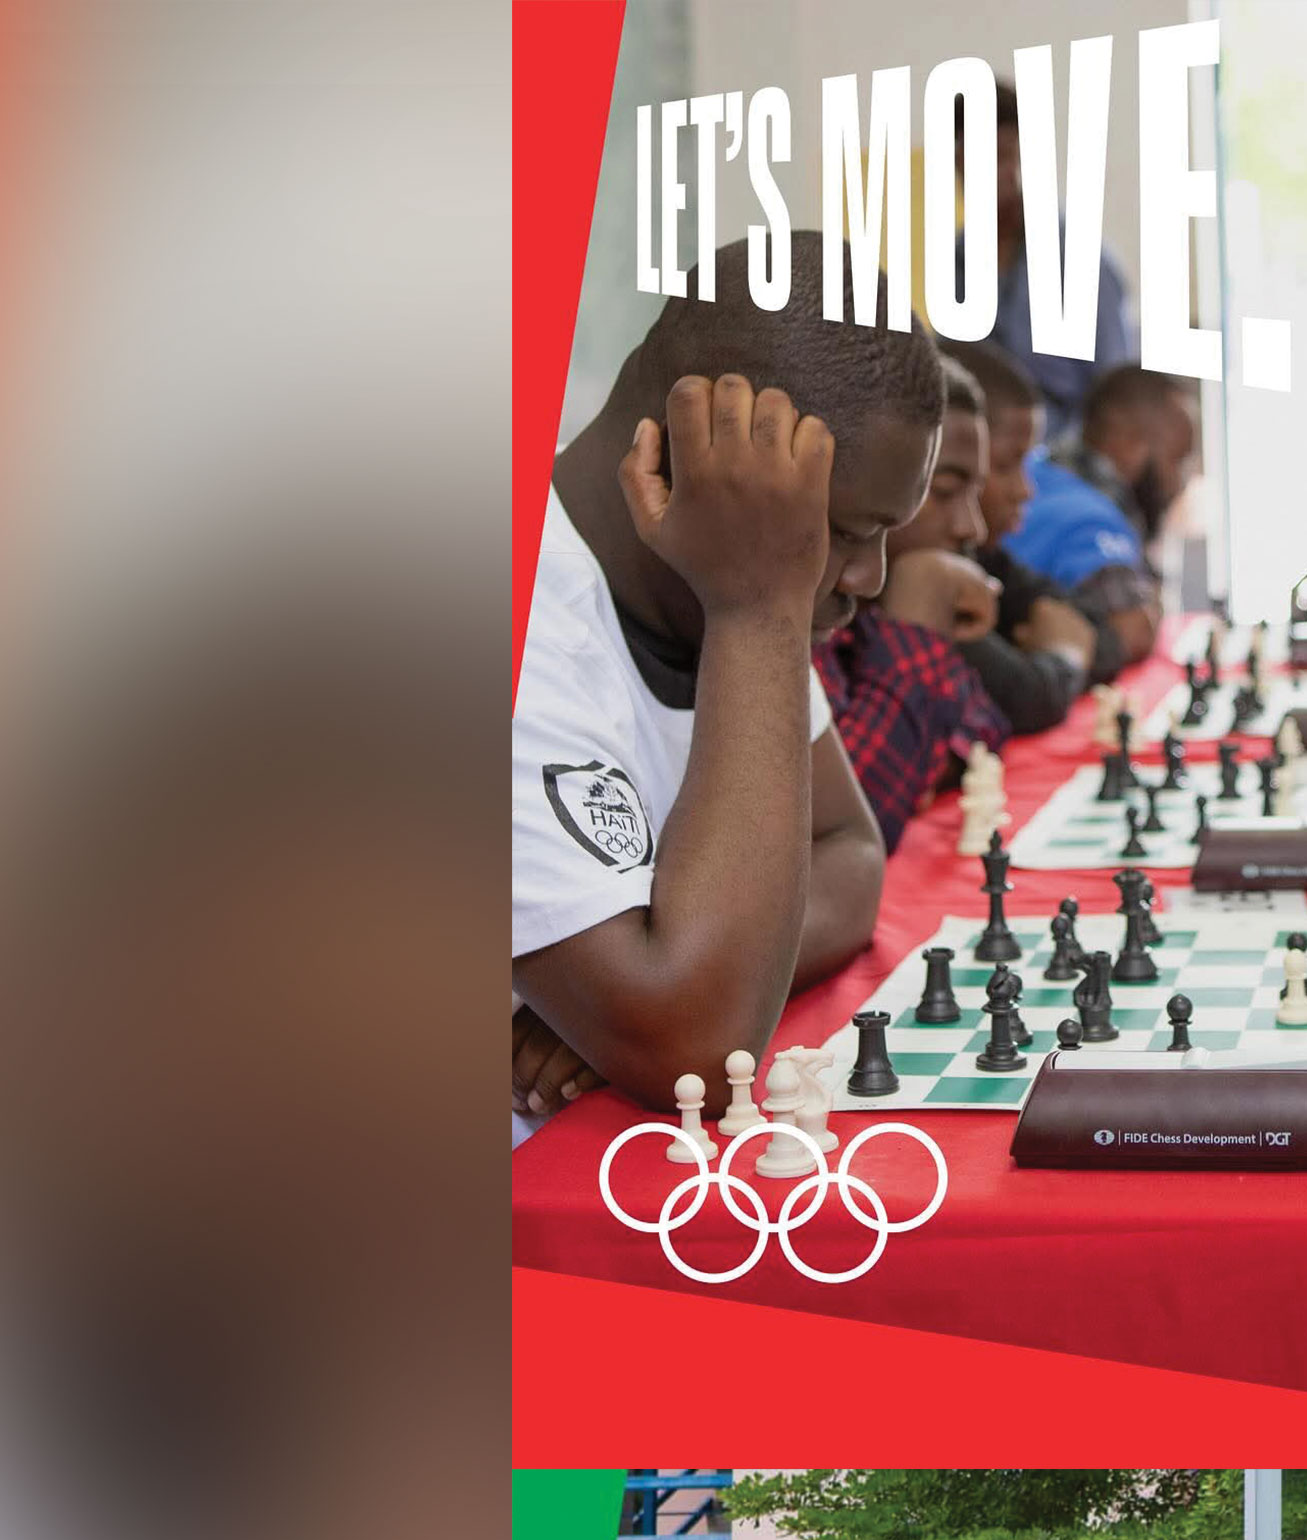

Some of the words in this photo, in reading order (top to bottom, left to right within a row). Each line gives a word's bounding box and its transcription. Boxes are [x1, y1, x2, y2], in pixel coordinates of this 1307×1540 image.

[1124, 1133, 1148, 1144] FIDE
[1151, 1133, 1181, 1144] Chess
[1183, 1133, 1256, 1146] Development
[1266, 1132, 1291, 1146] DGT
